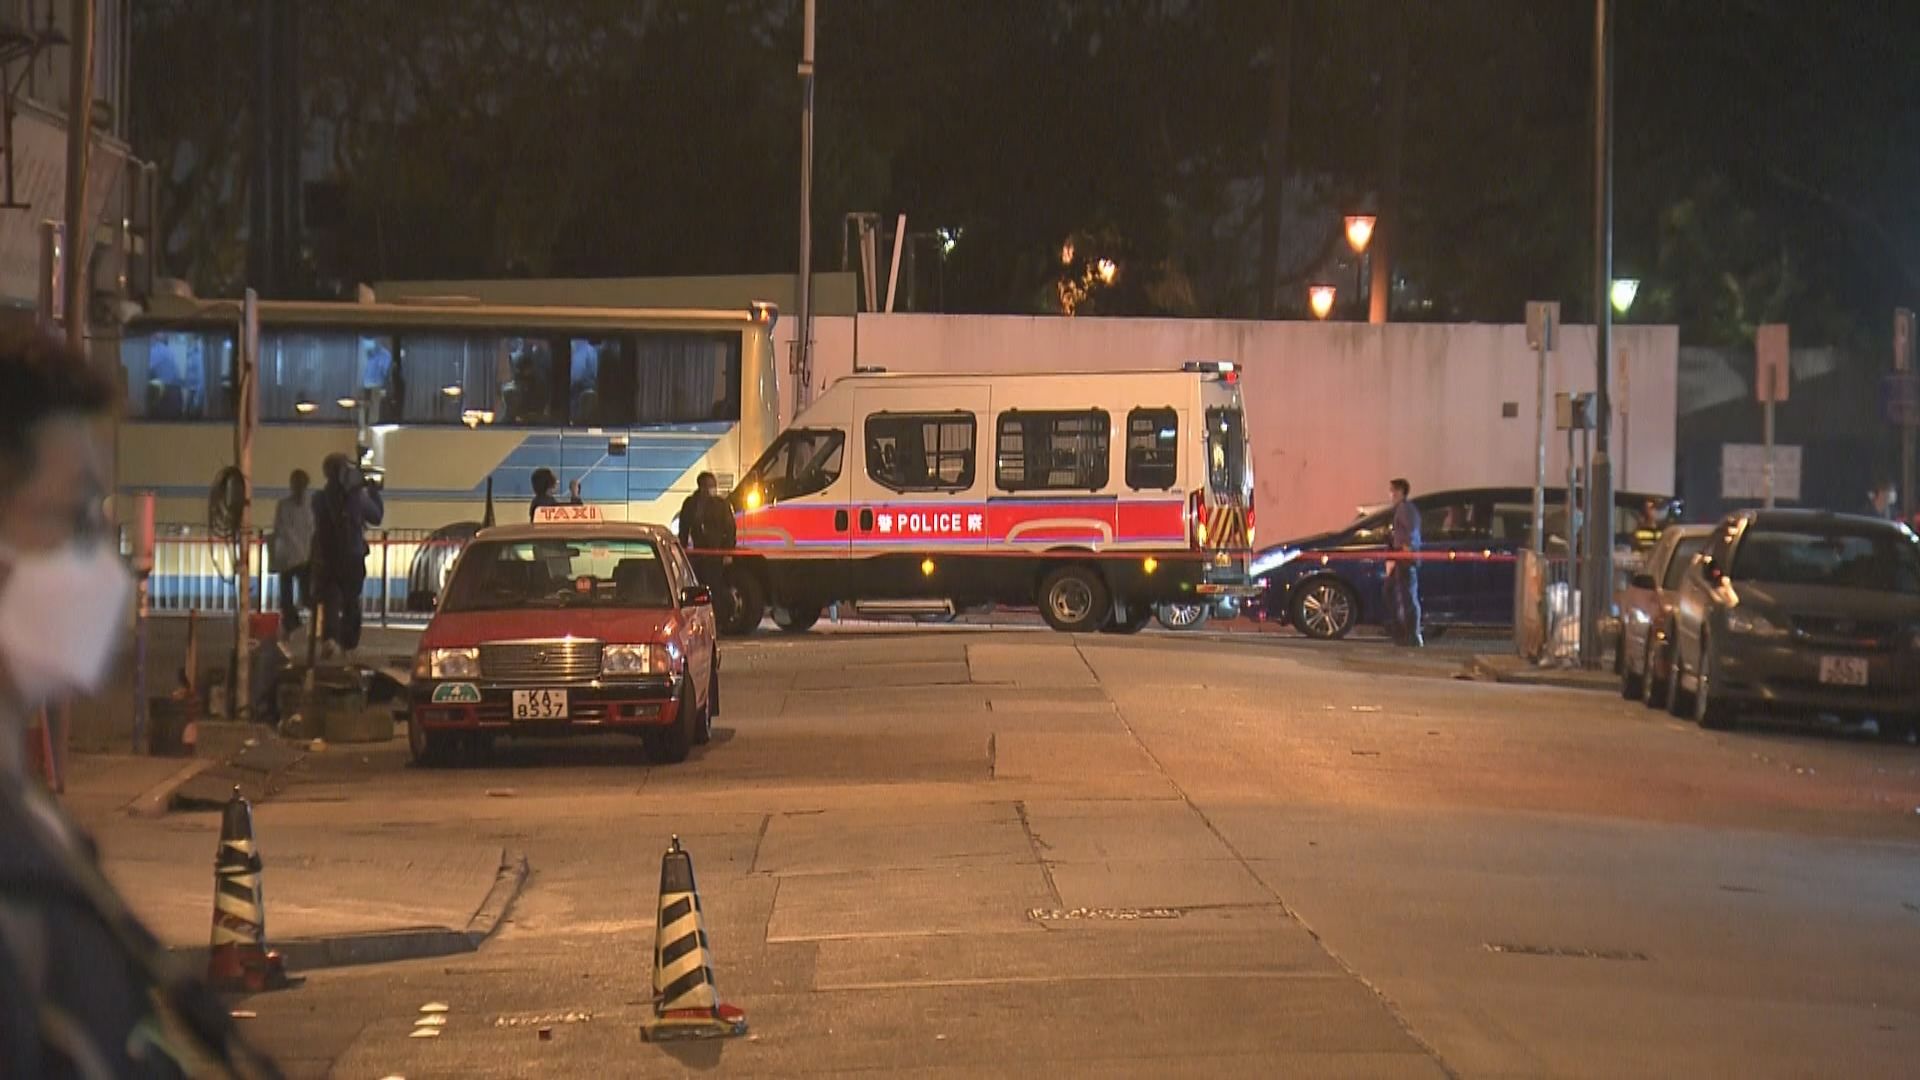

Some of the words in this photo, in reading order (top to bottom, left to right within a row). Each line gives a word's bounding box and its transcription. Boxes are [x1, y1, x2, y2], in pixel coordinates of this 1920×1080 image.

[541, 507, 596, 520] TAXI
[897, 513, 962, 532] POLICE
[528, 687, 552, 706] KA
[518, 703, 564, 717] 8537
